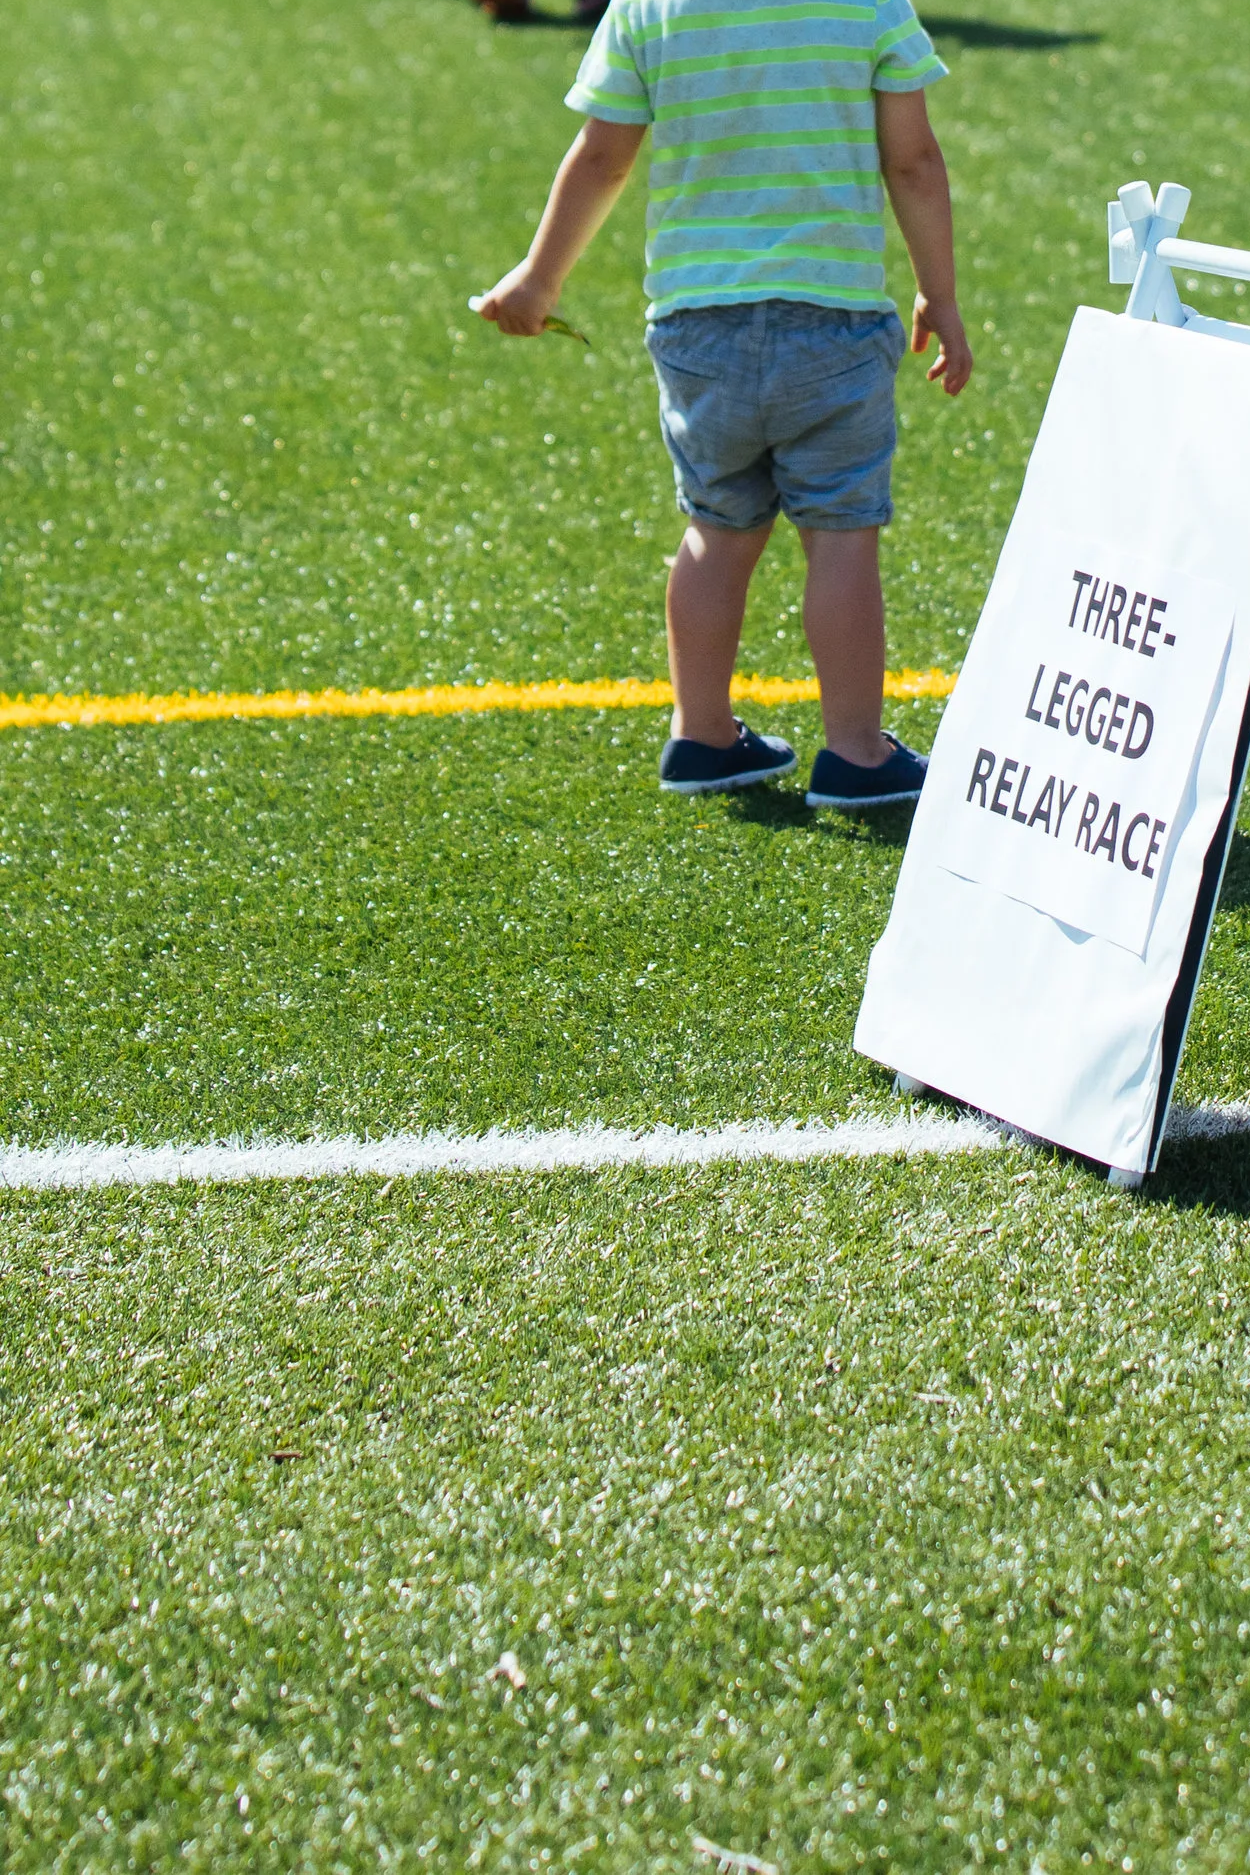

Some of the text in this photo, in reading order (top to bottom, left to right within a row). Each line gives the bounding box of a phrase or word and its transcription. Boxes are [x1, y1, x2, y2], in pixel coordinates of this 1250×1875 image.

[1068, 569, 1177, 658] THREE-
[1025, 663, 1155, 760] LEGGED
[966, 747, 1167, 880] RELAY RACE
